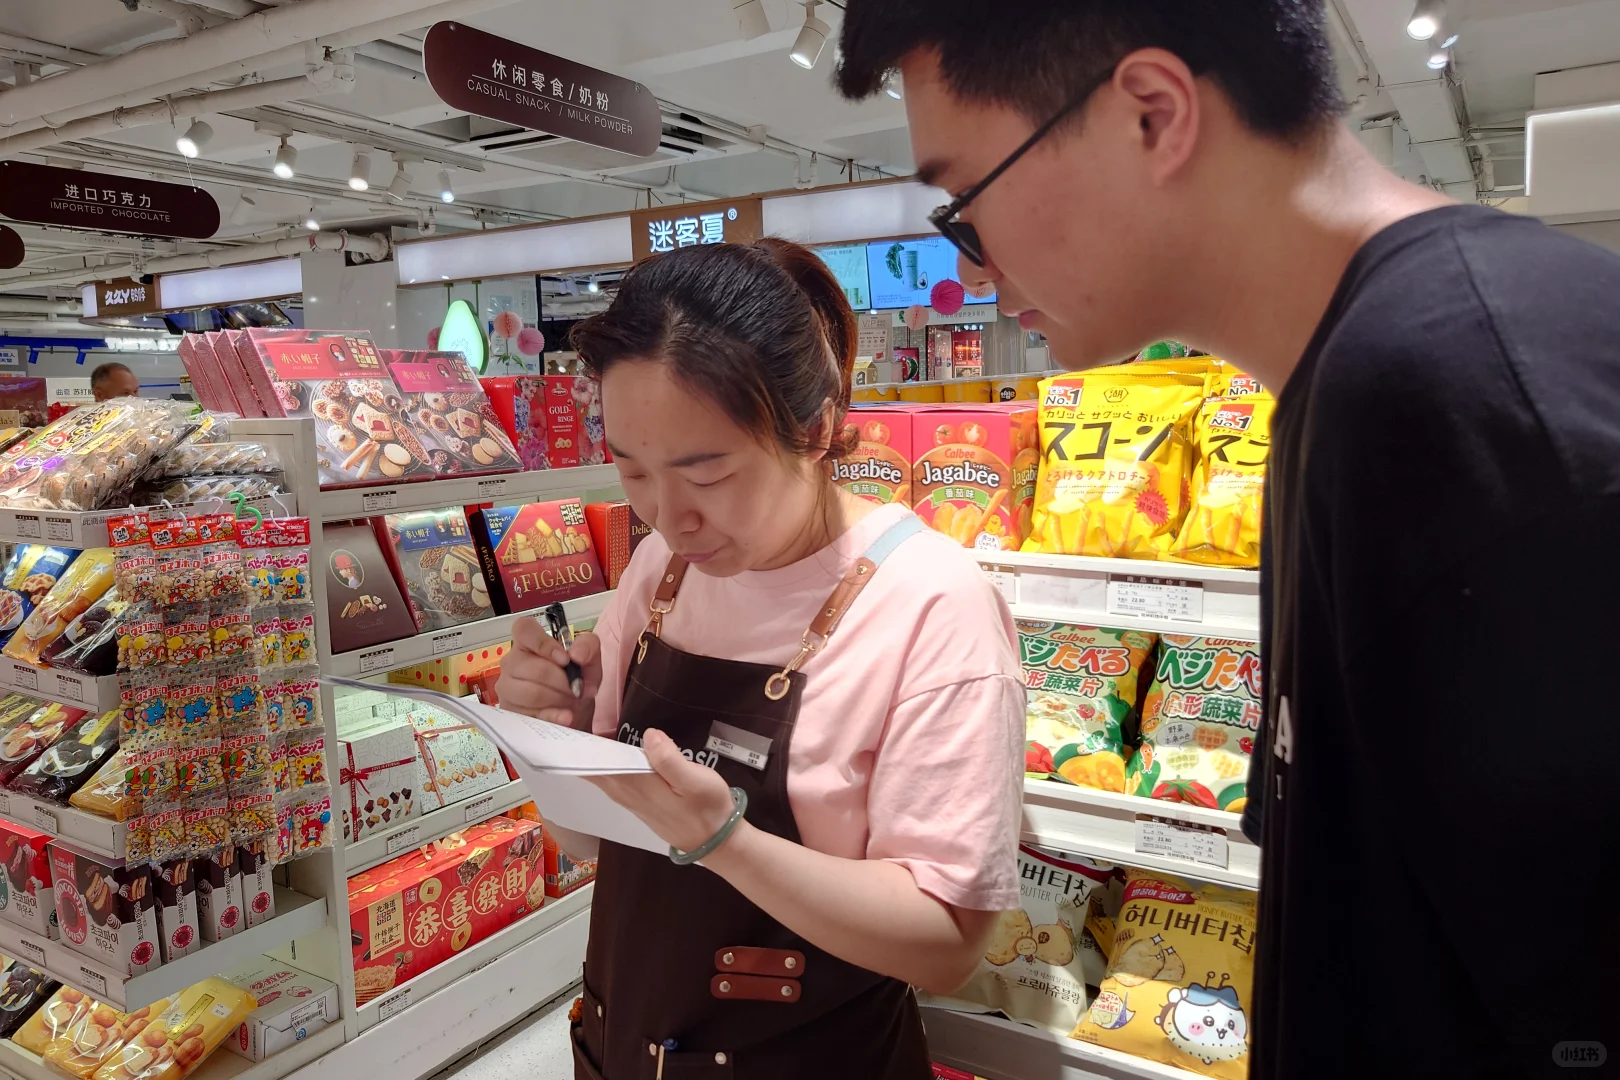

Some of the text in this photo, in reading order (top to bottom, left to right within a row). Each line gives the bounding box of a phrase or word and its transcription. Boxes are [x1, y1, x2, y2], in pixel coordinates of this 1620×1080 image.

[491, 58, 609, 111] 休闲零食/奶粉
[467, 78, 511, 101] CASUAL
[515, 92, 551, 113] SNACK
[567, 108, 591, 124] MILK
[594, 115, 633, 135] POWDER
[65, 184, 152, 208] 进口巧克力
[50, 201, 171, 223] IMPORTED CHOCOLATE
[649, 212, 726, 252] 迷客夏
[281, 353, 320, 364] 赤い帽子
[1045, 389, 1080, 406] No.1
[1046, 410, 1086, 420] カリッと
[1091, 411, 1133, 420] サクッと
[1211, 416, 1250, 430] No.1
[1044, 421, 1175, 462] スコーン
[945, 448, 975, 459] Calbee
[831, 459, 902, 483] Jagabee
[922, 461, 999, 487] Jagabee
[852, 485, 879, 494] 番茄味
[945, 488, 974, 499] 番茄味
[159, 558, 201, 573] タマゴボーロ
[203, 552, 240, 566] タマゴボーロ
[520, 562, 593, 593] FIGARO
[211, 613, 251, 628] タマゴボーロ
[165, 622, 208, 637] タマゴボーロ
[1050, 631, 1096, 645] Calbee
[1023, 670, 1100, 696] 形蔬菜片
[617, 723, 644, 746] Cit
[1168, 724, 1183, 733] 野菜
[1017, 858, 1092, 908] 버터칩
[11, 891, 38, 908] 초코파이
[1020, 884, 1051, 902] BUTTER
[16, 902, 35, 916] 하우스
[376, 898, 396, 914] 北海道
[412, 862, 530, 943] 恭喜發財
[1197, 904, 1219, 917] HONEY
[91, 924, 119, 944] 초코파이
[1125, 904, 1258, 956] 허니버터칩
[95, 937, 116, 954] 하우스
